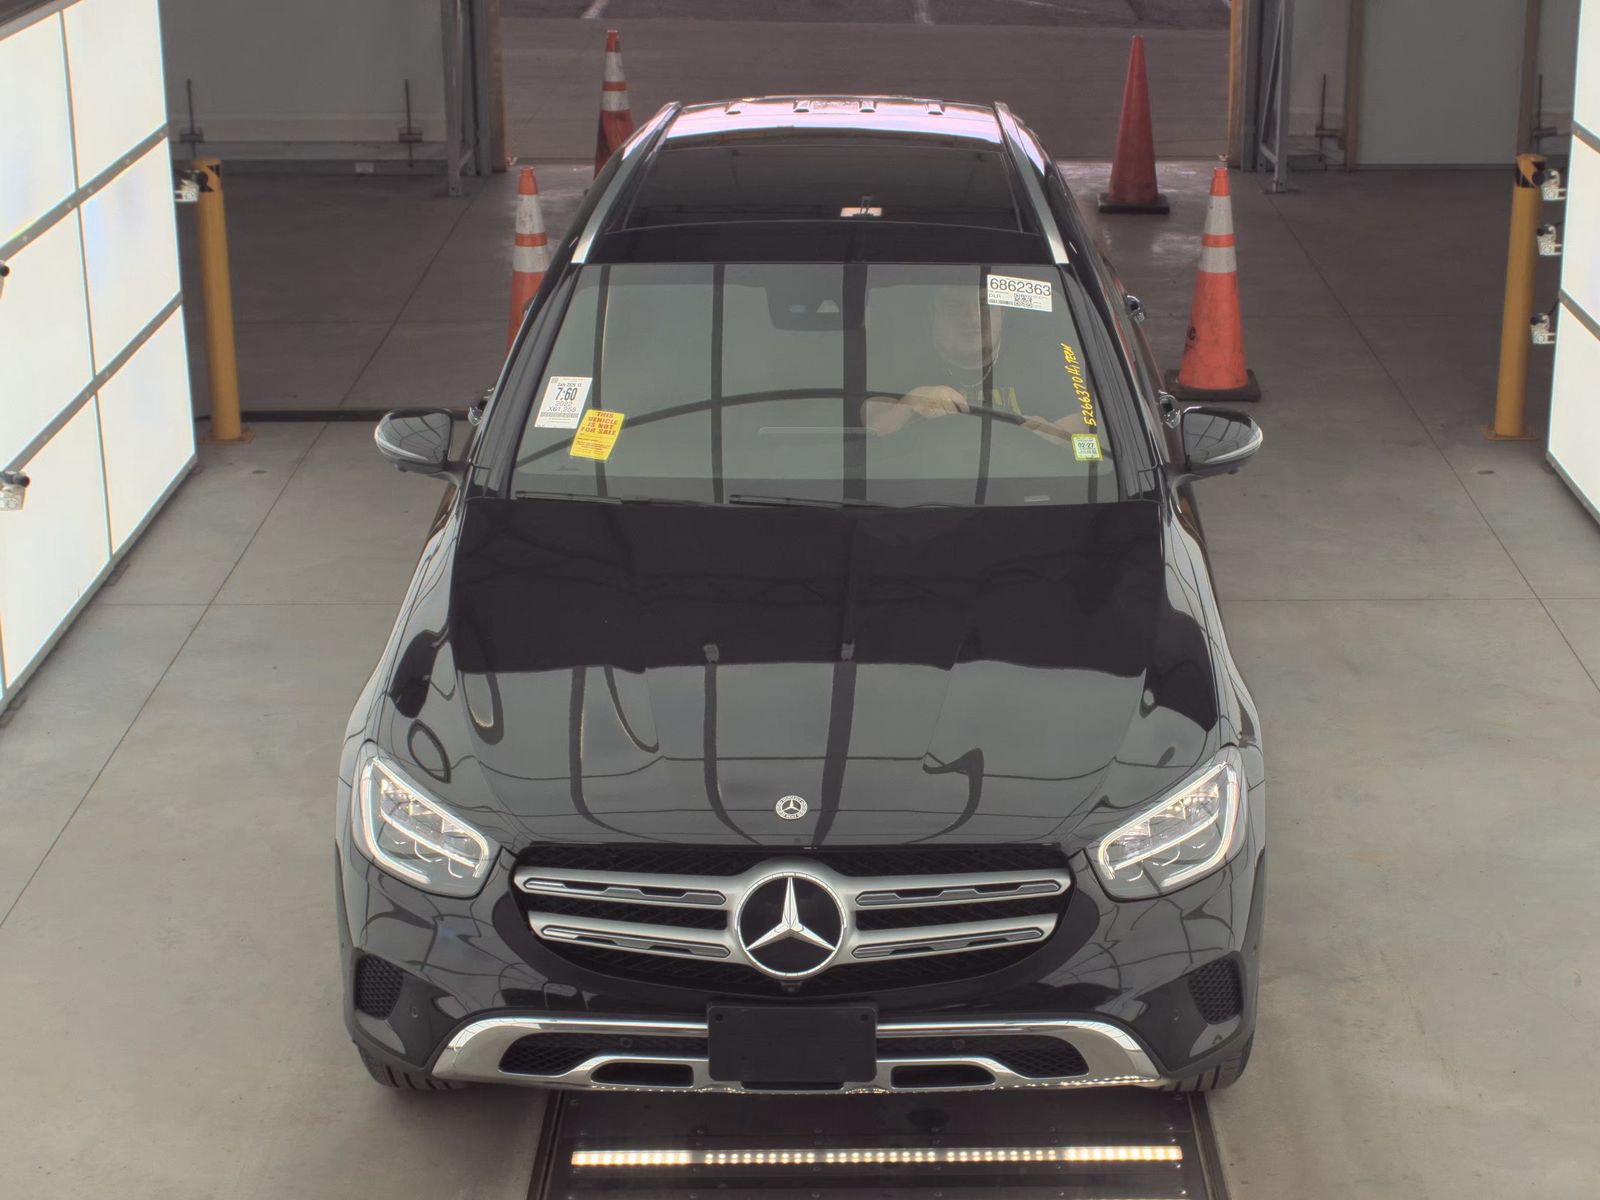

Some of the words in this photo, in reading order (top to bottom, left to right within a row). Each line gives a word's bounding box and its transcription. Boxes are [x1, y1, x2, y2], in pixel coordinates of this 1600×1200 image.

[990, 278, 1050, 296] 6862363
[555, 387, 578, 400] 7:60
[1072, 376, 1096, 426] 5266370
[588, 416, 617, 425] VEHICLE
